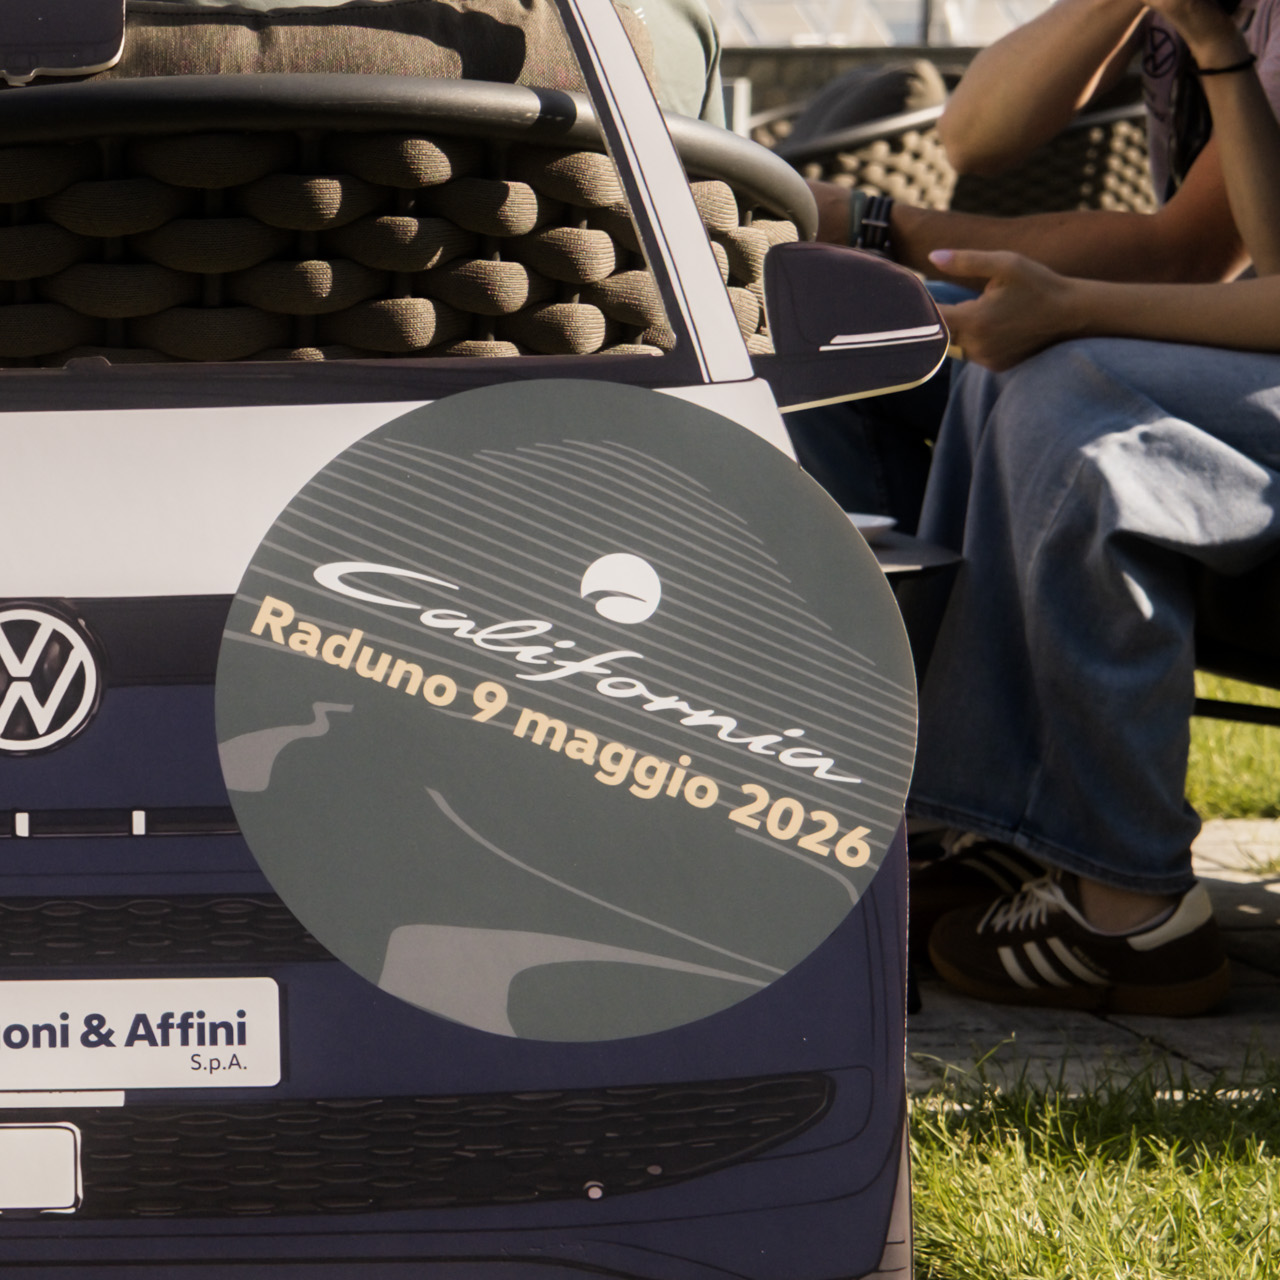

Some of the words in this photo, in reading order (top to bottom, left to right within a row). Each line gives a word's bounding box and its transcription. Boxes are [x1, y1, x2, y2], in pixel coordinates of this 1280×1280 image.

[250, 595, 458, 707] Raduno
[472, 681, 508, 723] 9
[513, 707, 719, 809] maggio
[728, 783, 871, 868] 2026
[313, 561, 862, 783] California
[80, 1013, 116, 1049] &
[124, 1009, 247, 1047] Affini
[190, 1053, 248, 1074] S.p.A.
